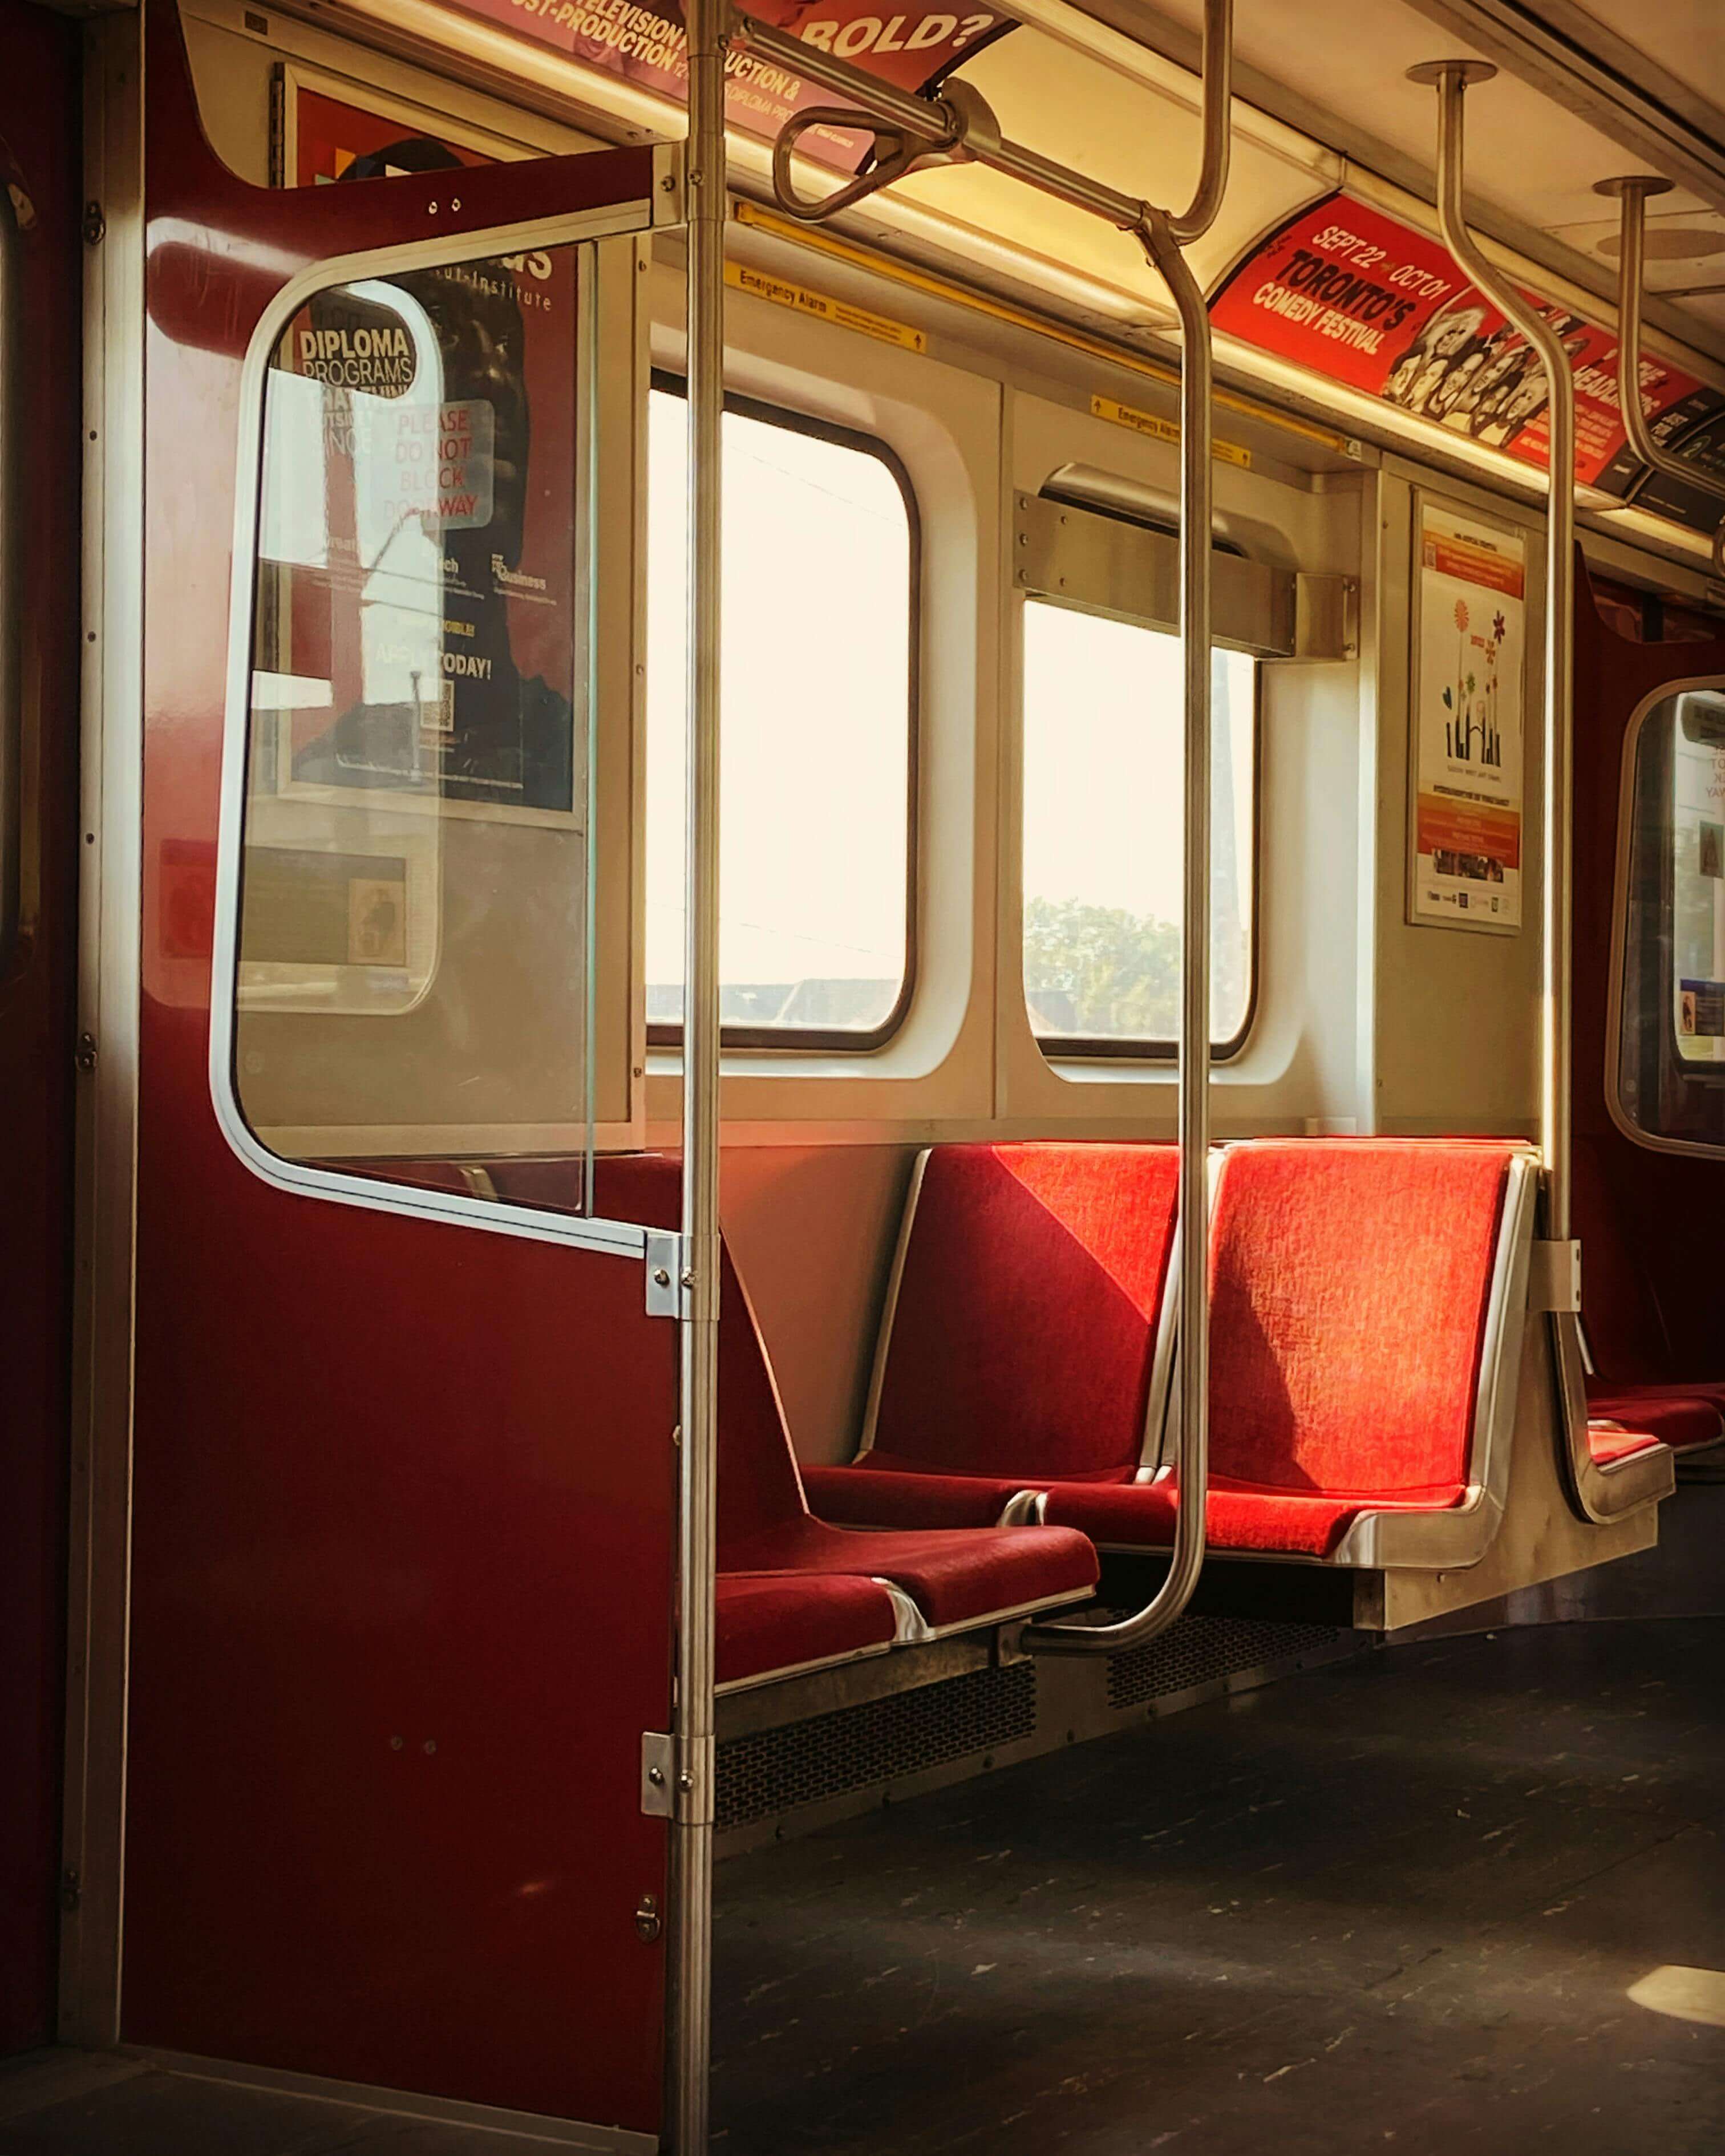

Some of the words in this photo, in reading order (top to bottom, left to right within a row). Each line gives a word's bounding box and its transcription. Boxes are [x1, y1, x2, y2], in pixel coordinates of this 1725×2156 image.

[800, 14, 994, 58] BOLD?
[1313, 226, 1367, 257] SEPT
[1350, 246, 1387, 269] 22
[1389, 265, 1434, 290] OCT
[1418, 278, 1451, 301] 01
[740, 269, 796, 305] Emergency
[799, 291, 827, 313] Alarm
[1275, 249, 1416, 331] TORONTO'S
[1253, 282, 1325, 327] COMEDY
[1313, 305, 1386, 355] FESTIVAL
[300, 329, 410, 359] DIPLOMA
[303, 357, 414, 386] PROGRAMS
[398, 409, 469, 435] PLEASE
[395, 441, 421, 464] DO
[432, 437, 472, 461] NOT
